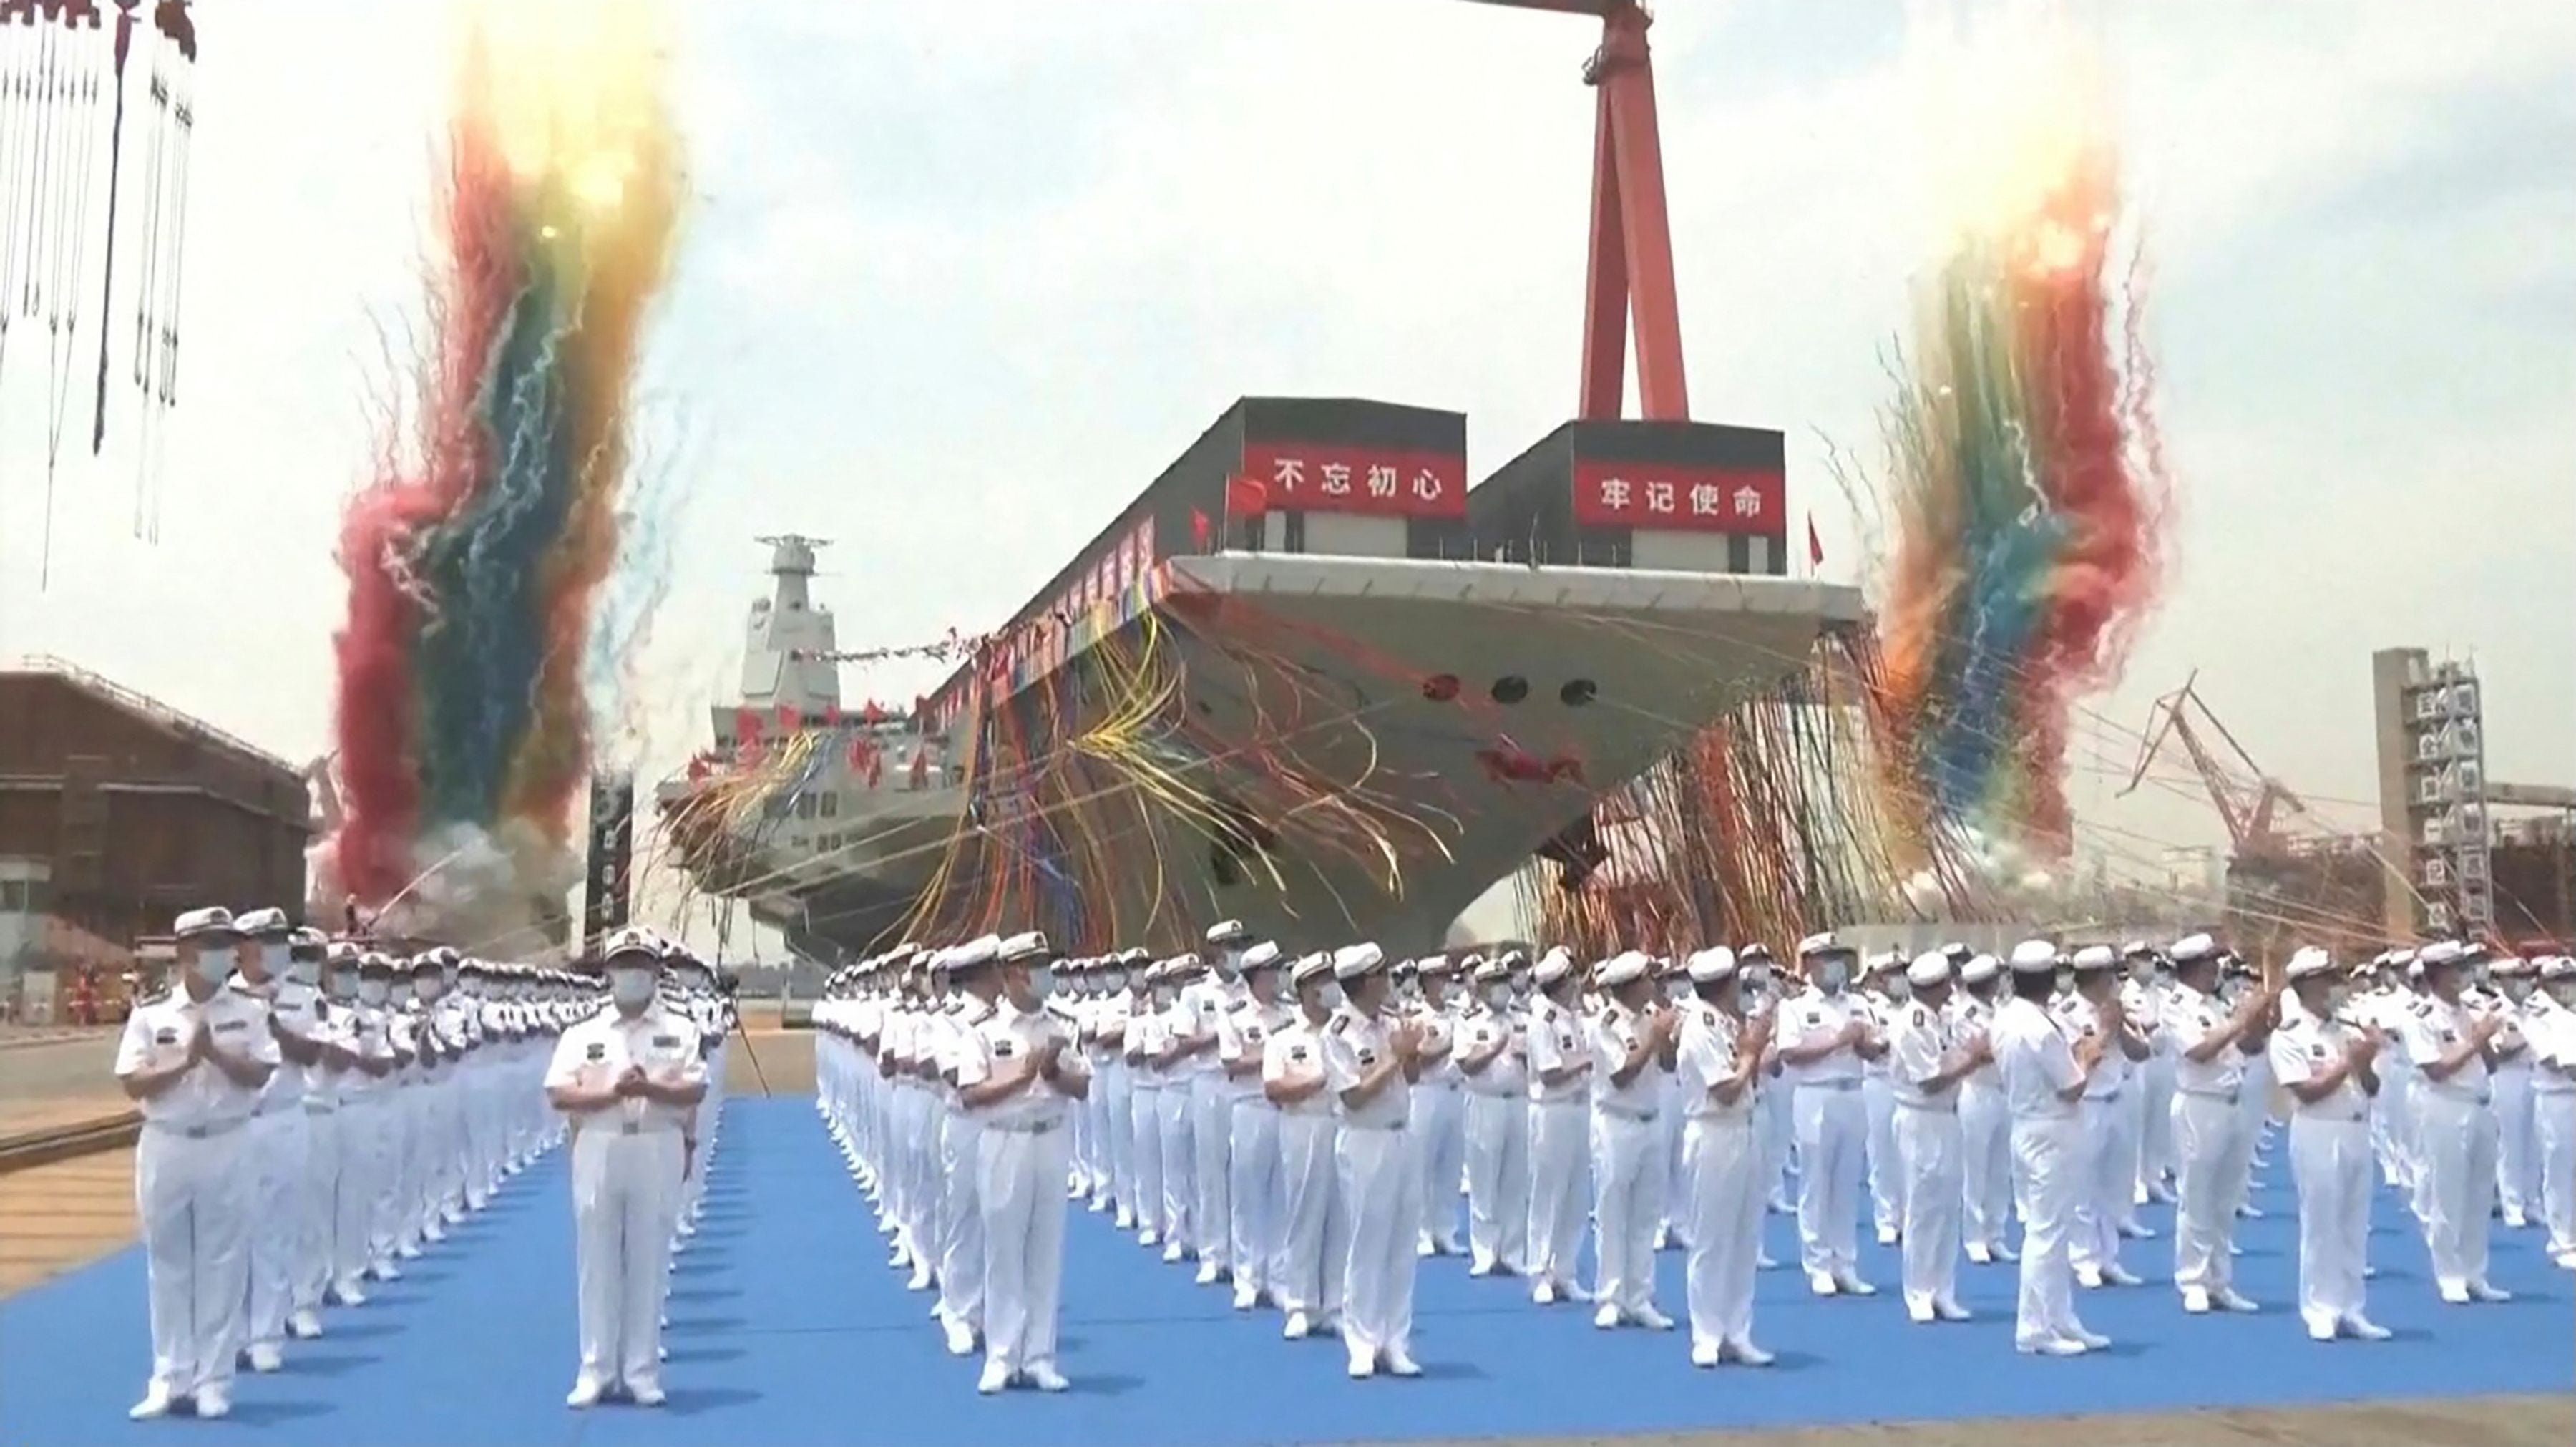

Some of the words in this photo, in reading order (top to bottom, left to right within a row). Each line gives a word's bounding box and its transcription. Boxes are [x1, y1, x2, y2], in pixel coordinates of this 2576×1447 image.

[1274, 458, 1442, 500] 不忘初心
[1601, 478, 1761, 517] 牢记使命
